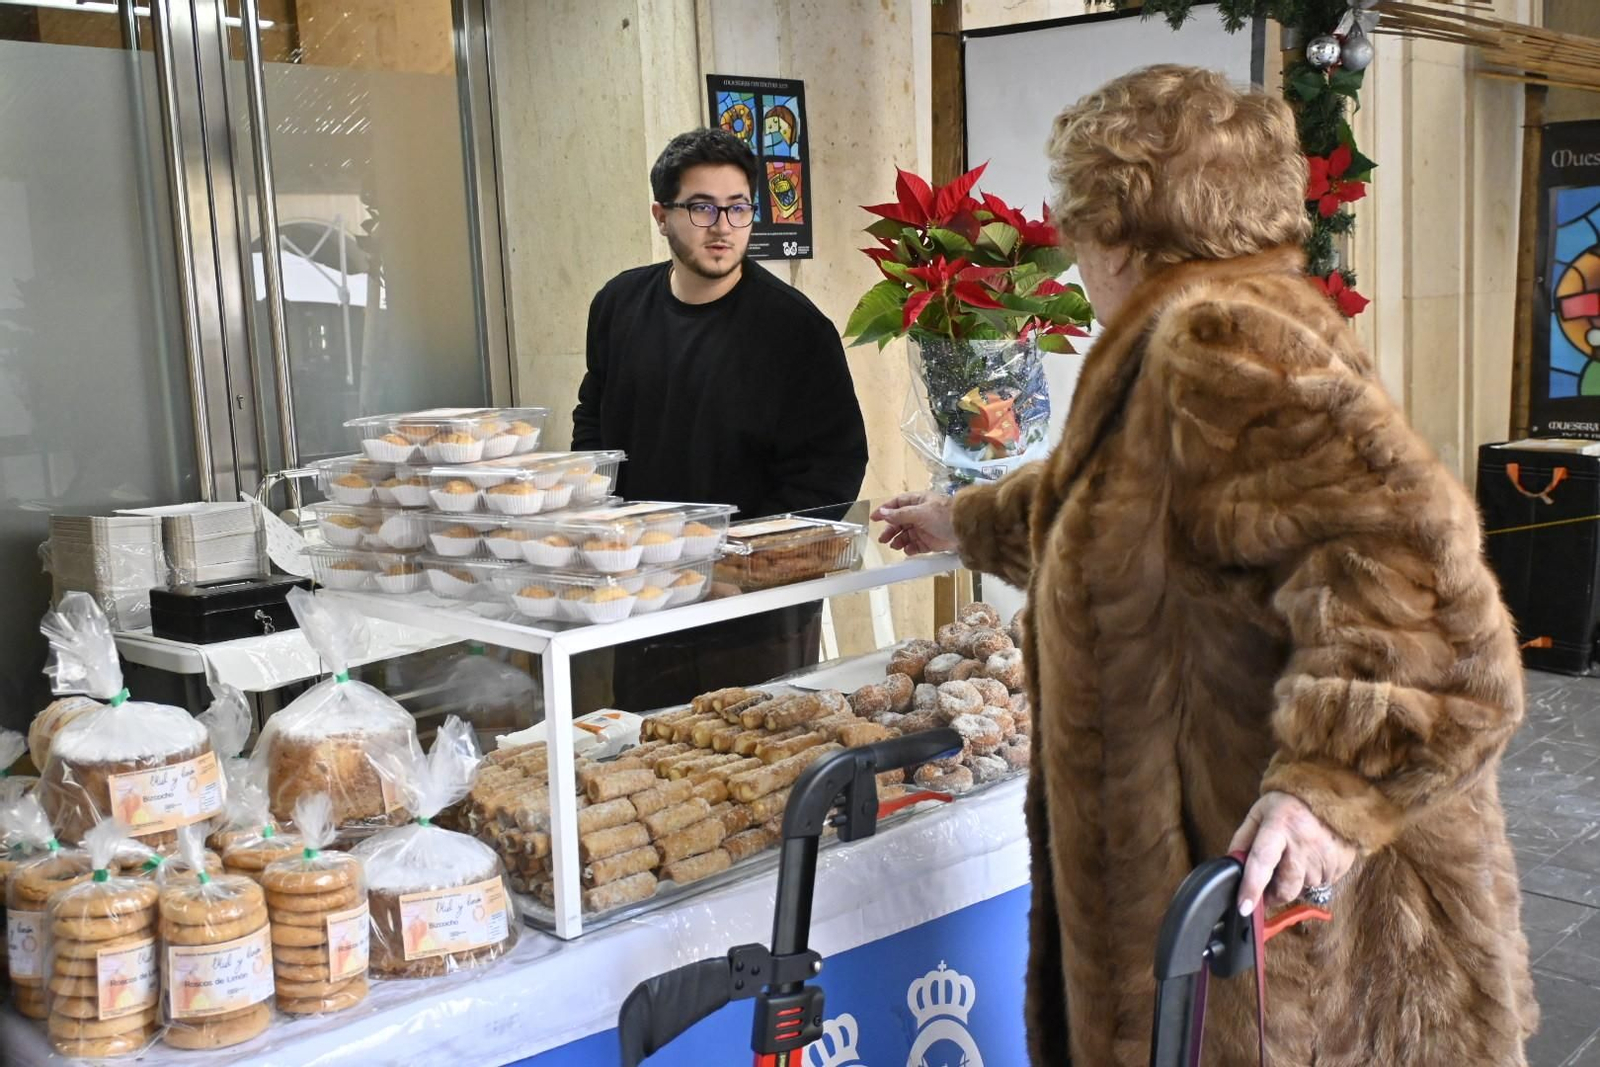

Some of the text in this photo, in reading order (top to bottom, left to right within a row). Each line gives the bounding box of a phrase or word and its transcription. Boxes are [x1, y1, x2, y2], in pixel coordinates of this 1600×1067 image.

[142, 792, 174, 803] Bizcocho
[428, 919, 459, 930] Bizcocho
[110, 976, 138, 988] Roscos
[184, 972, 249, 988] Roscos de Limón
